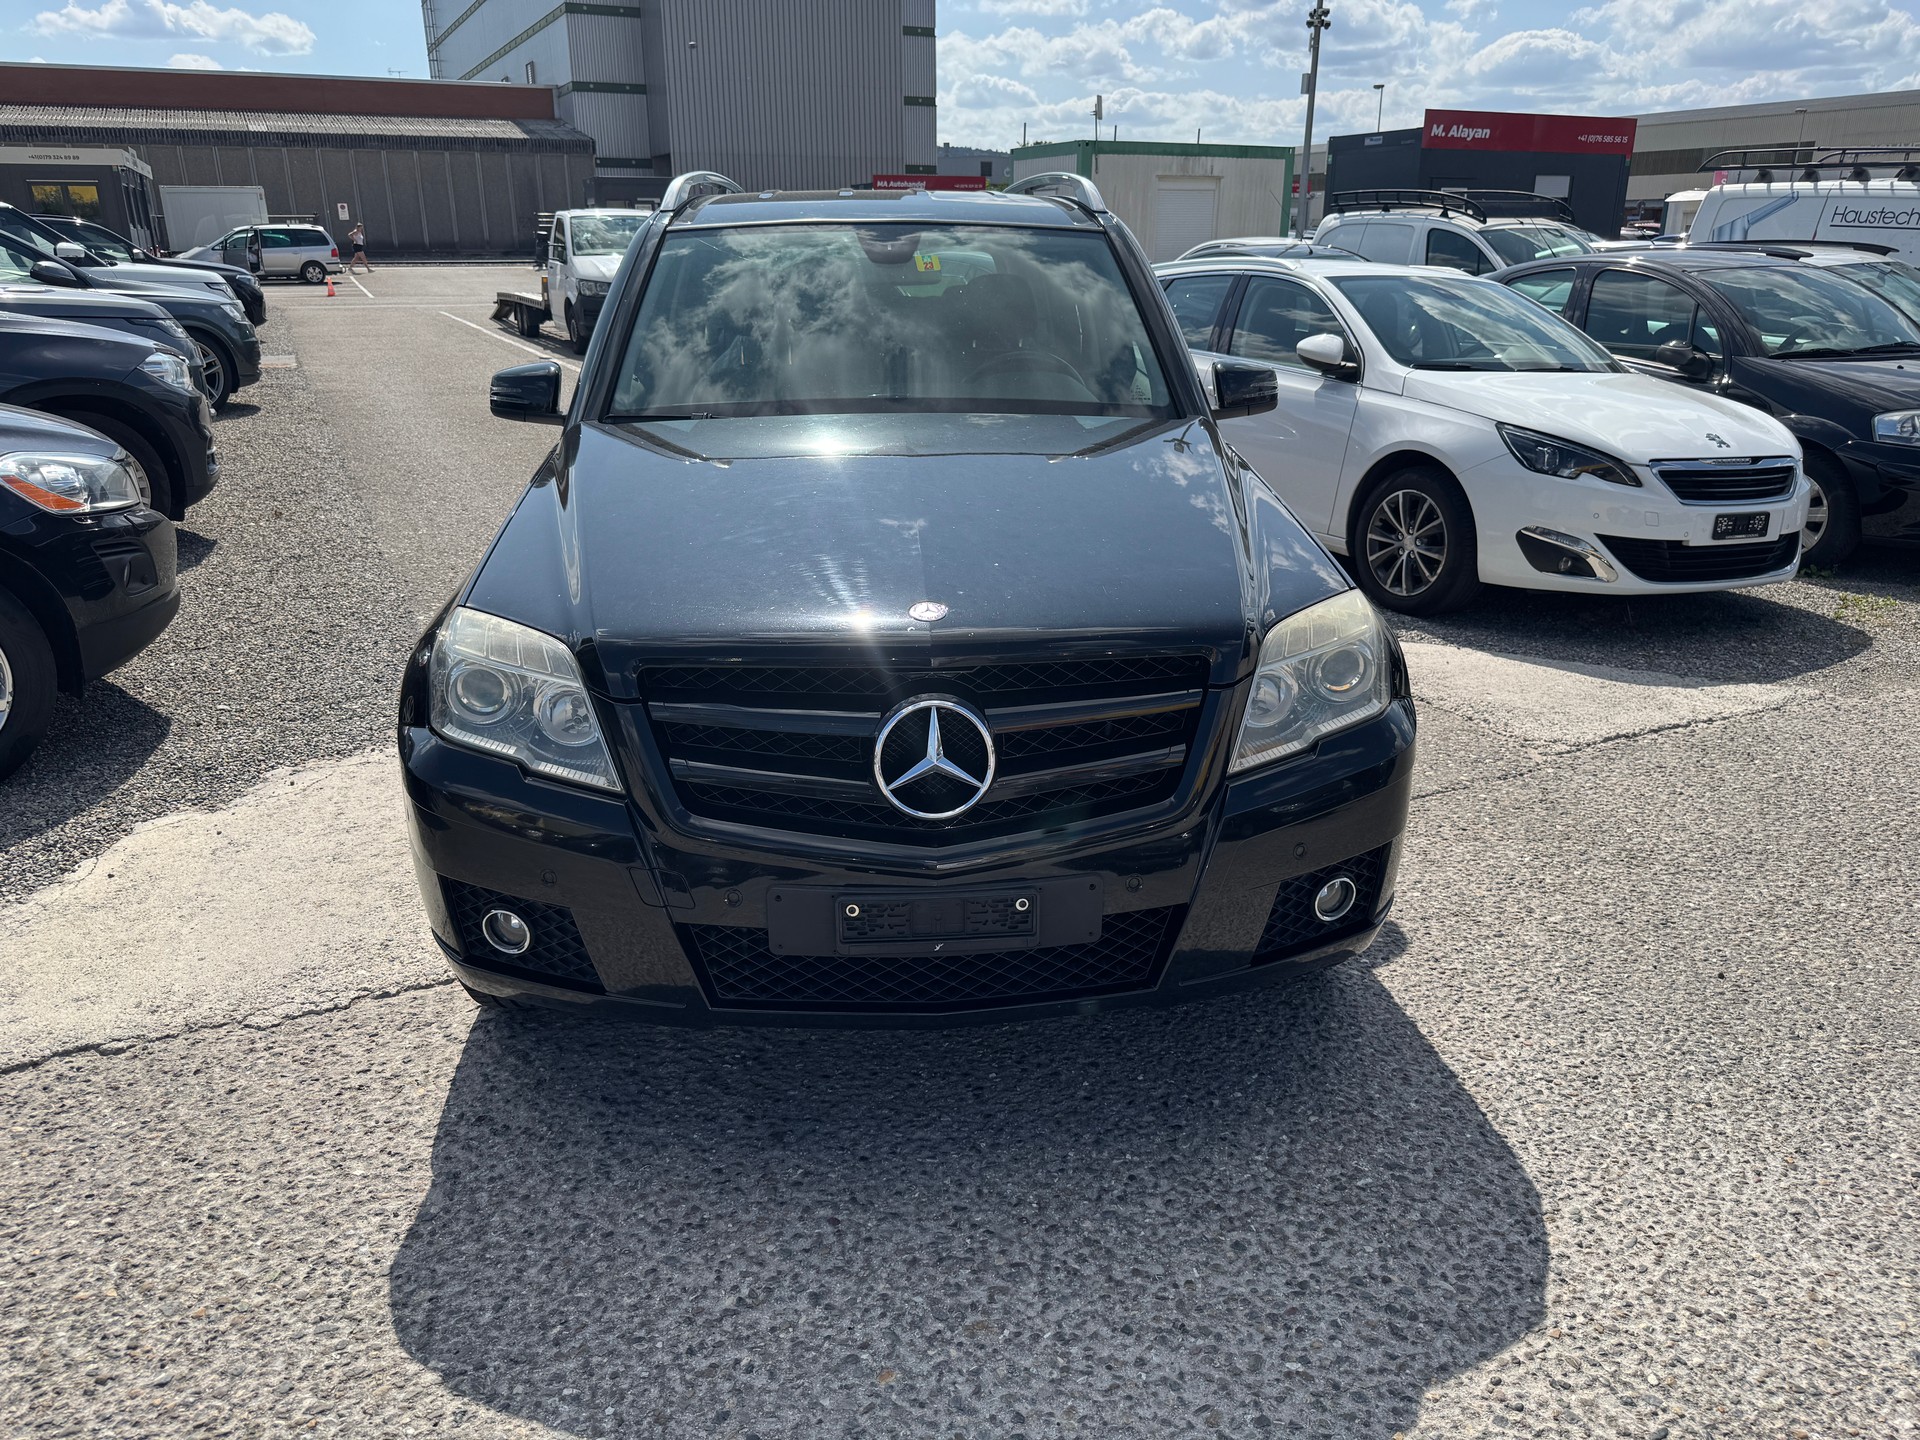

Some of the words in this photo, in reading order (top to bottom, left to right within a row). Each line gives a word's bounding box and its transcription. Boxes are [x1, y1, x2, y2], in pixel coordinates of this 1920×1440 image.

[1430, 123, 1446, 137] M.
[1447, 124, 1491, 141] Alayan
[1621, 136, 1629, 144] 15
[876, 180, 888, 188] MA
[1830, 205, 1920, 226] Haustech
